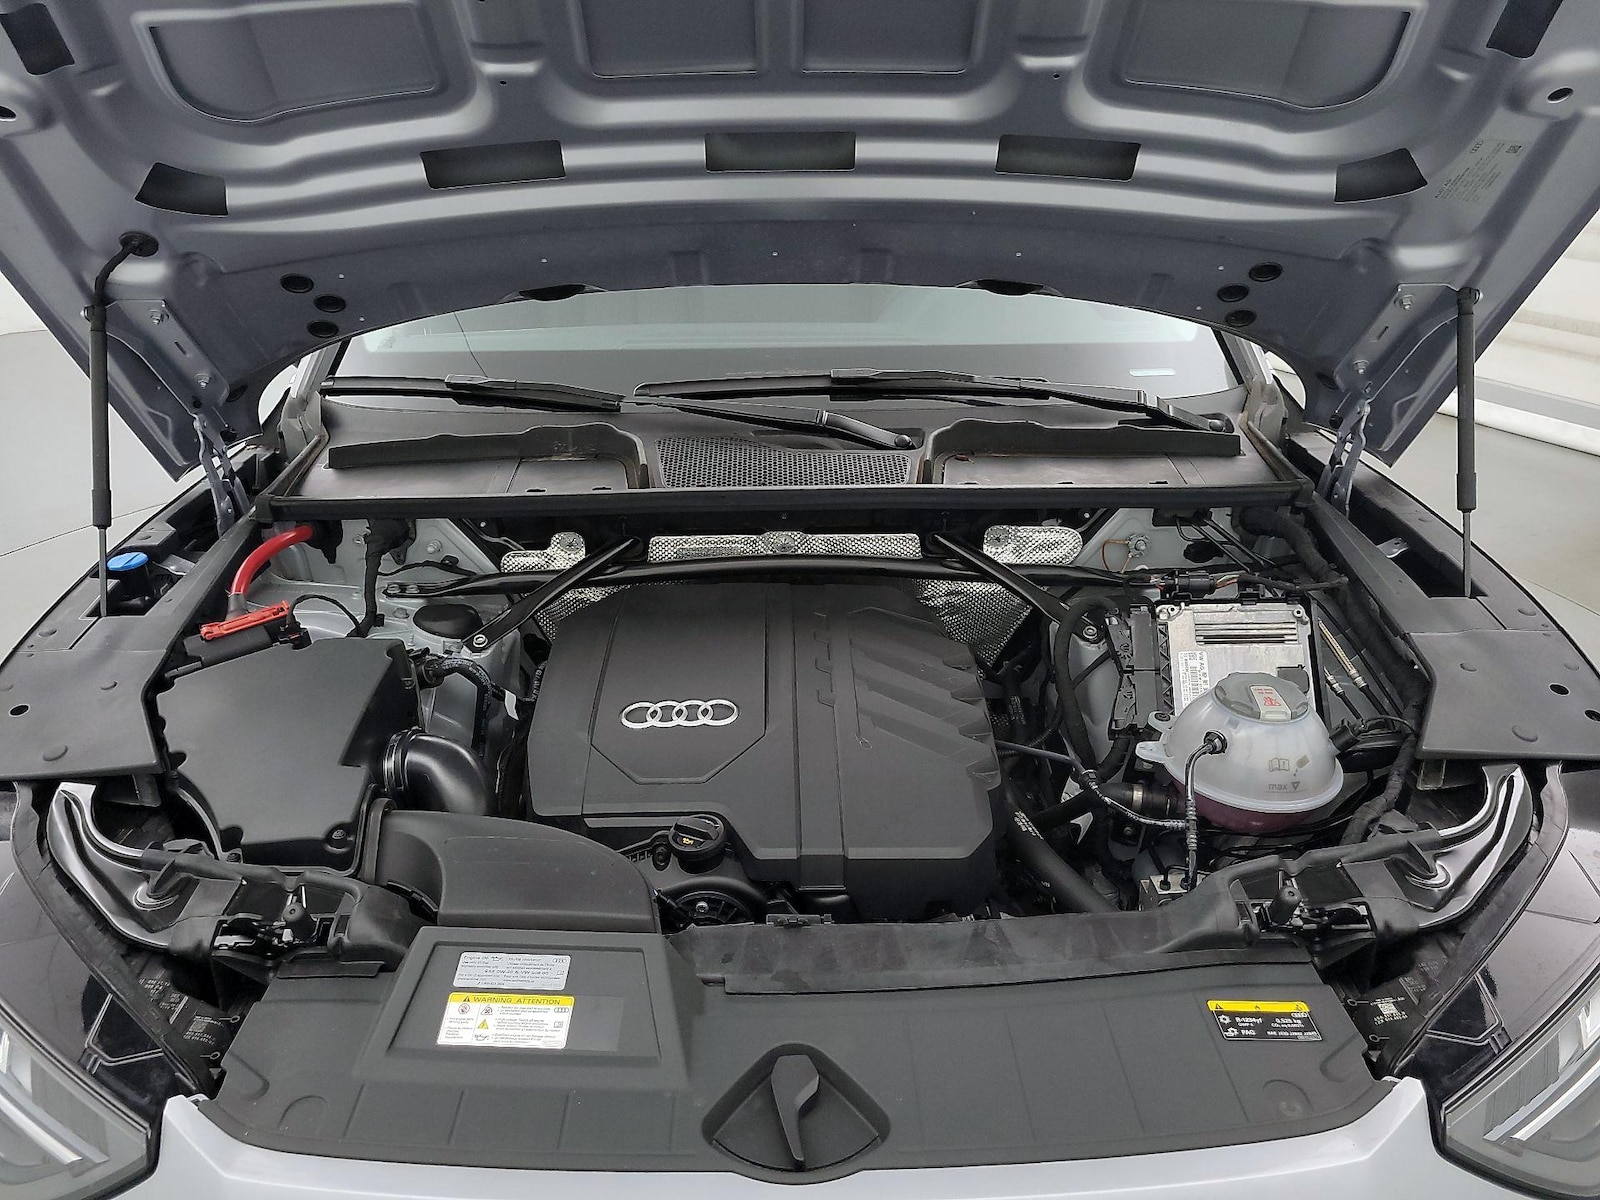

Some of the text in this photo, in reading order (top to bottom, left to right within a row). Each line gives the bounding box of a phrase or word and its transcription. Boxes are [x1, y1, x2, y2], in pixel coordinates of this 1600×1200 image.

[1268, 783, 1288, 791] max
[473, 996, 561, 1005] WARNING ATTENTION
